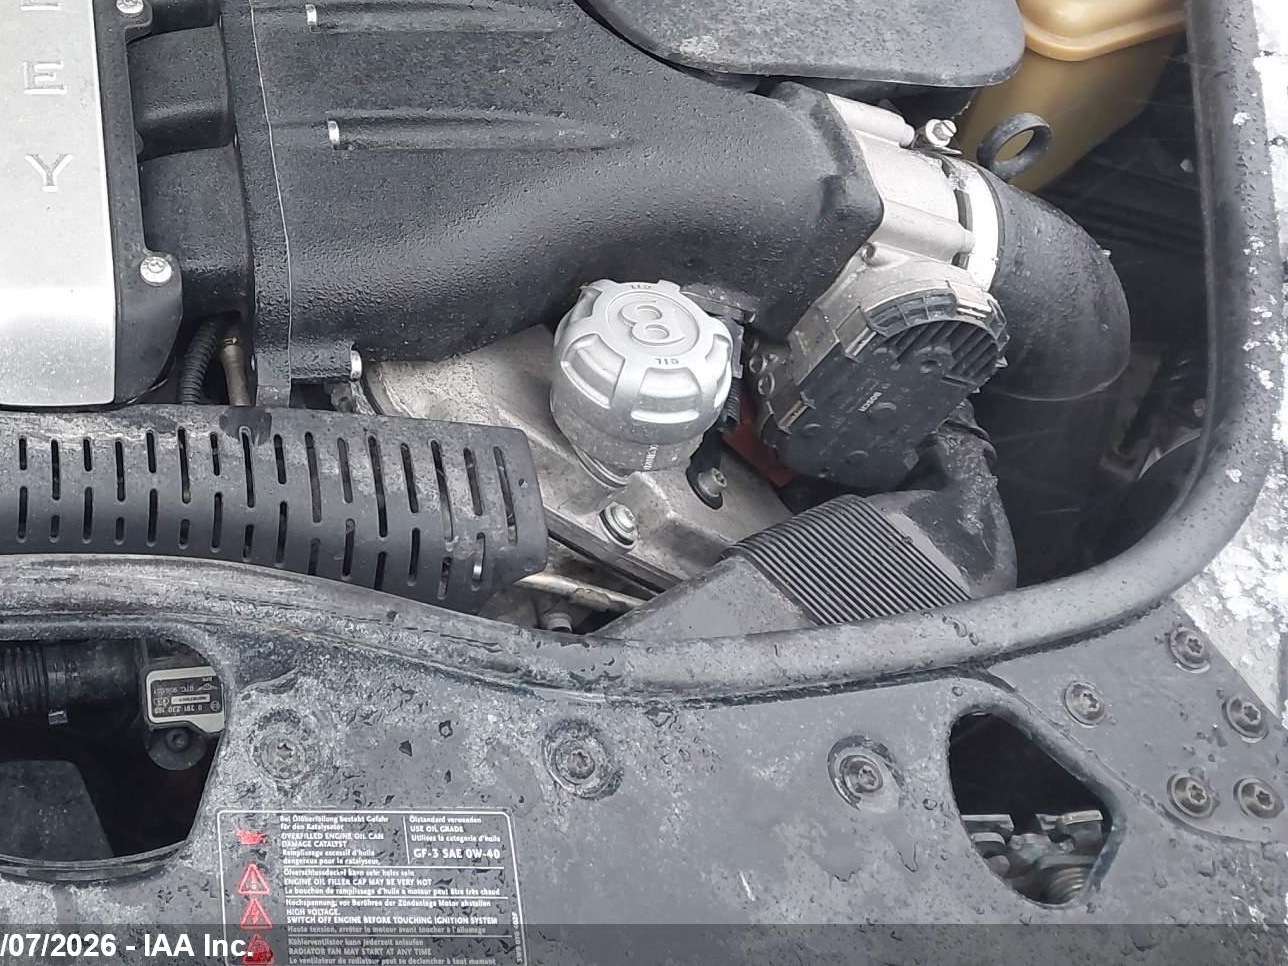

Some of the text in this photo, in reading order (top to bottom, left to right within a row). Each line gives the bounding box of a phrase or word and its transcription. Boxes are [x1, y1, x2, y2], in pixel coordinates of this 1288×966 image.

[413, 848, 501, 858] GF-3 SAE 0W-40
